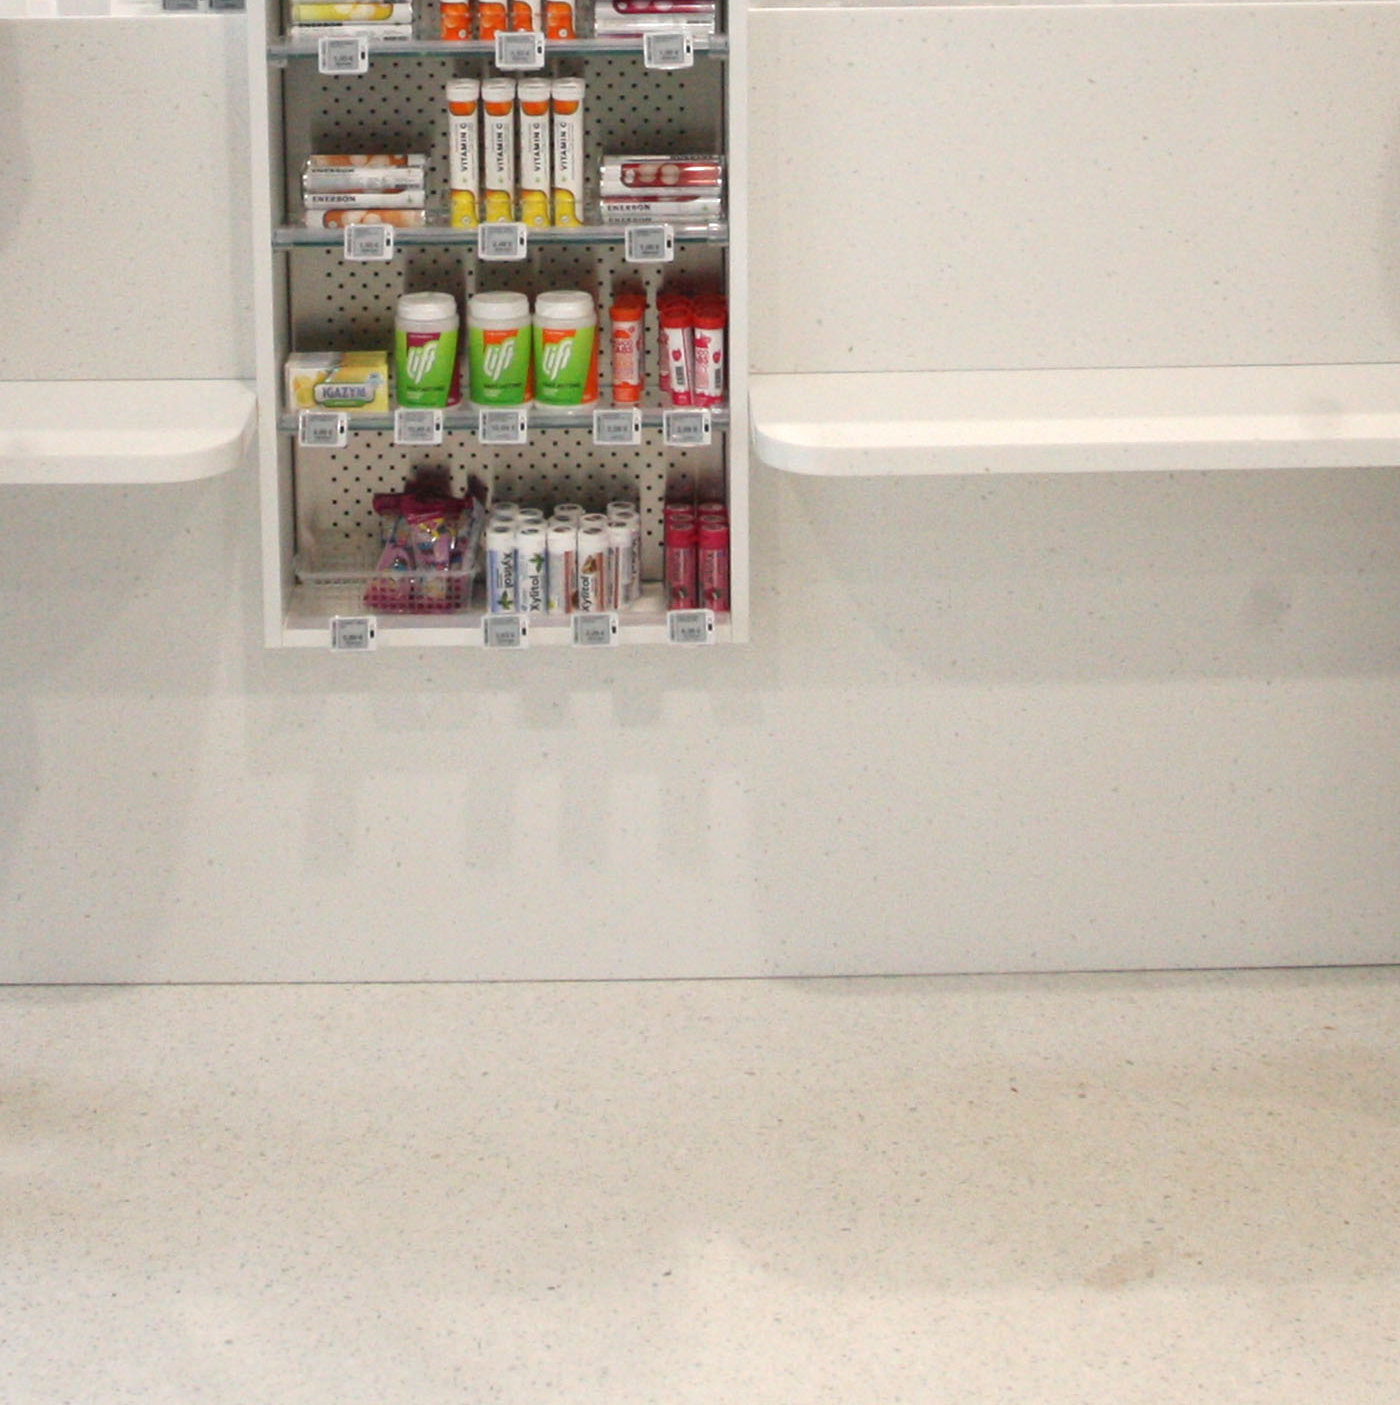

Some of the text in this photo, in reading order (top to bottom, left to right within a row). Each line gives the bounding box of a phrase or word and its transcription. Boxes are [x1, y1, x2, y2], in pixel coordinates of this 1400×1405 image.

[502, 552, 513, 588] Xylitol
[530, 575, 540, 611] Xylitol
[581, 576, 591, 613] Xylitol
